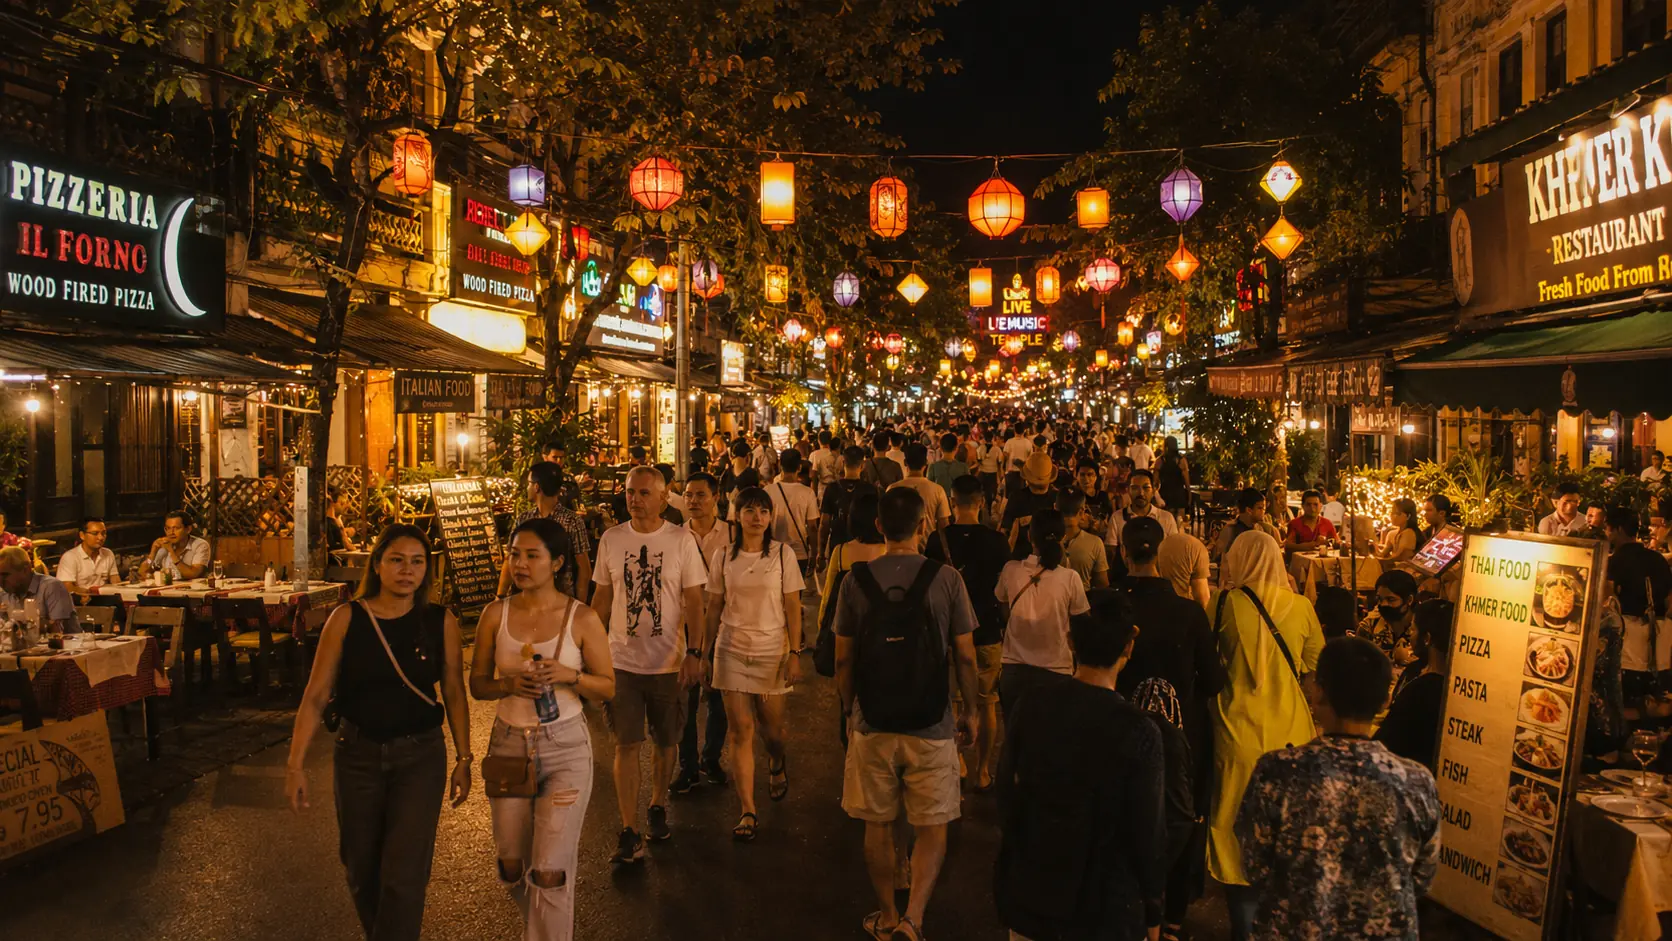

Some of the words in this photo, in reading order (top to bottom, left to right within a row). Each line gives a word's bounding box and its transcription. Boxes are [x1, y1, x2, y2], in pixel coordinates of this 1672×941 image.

[1640, 112, 1672, 190] K
[11, 160, 158, 229] PIZZERIA
[18, 221, 49, 259] IL
[57, 228, 147, 275] FORNO
[1552, 206, 1665, 265] RESTAURANT
[8, 272, 57, 299] WOOD
[63, 279, 109, 305] FIRED
[115, 287, 155, 311] PIZZA
[463, 273, 487, 292] WOOD
[514, 285, 535, 302] PIZZA
[1538, 276, 1573, 302] Fresh
[1575, 262, 1610, 295] Food
[1613, 254, 1654, 289] From
[1658, 254, 1672, 281] R
[1002, 300, 1032, 314] LIVE
[989, 333, 1043, 346] TEPLE
[401, 377, 442, 397] ITALIAN
[445, 379, 471, 397] FOOD
[1470, 555, 1495, 575] THAI
[1498, 558, 1531, 581] FOOD
[1464, 594, 1498, 618] KHMER
[1499, 601, 1528, 623] FOOD
[1459, 634, 1491, 659] PIZZA
[1453, 676, 1487, 702] PASTA
[1447, 716, 1484, 745] STEAK
[1442, 758, 1469, 785] FISH
[14, 795, 63, 836] 7.95
[1440, 803, 1471, 831] ALAD
[1439, 844, 1492, 886] ANDWICH
